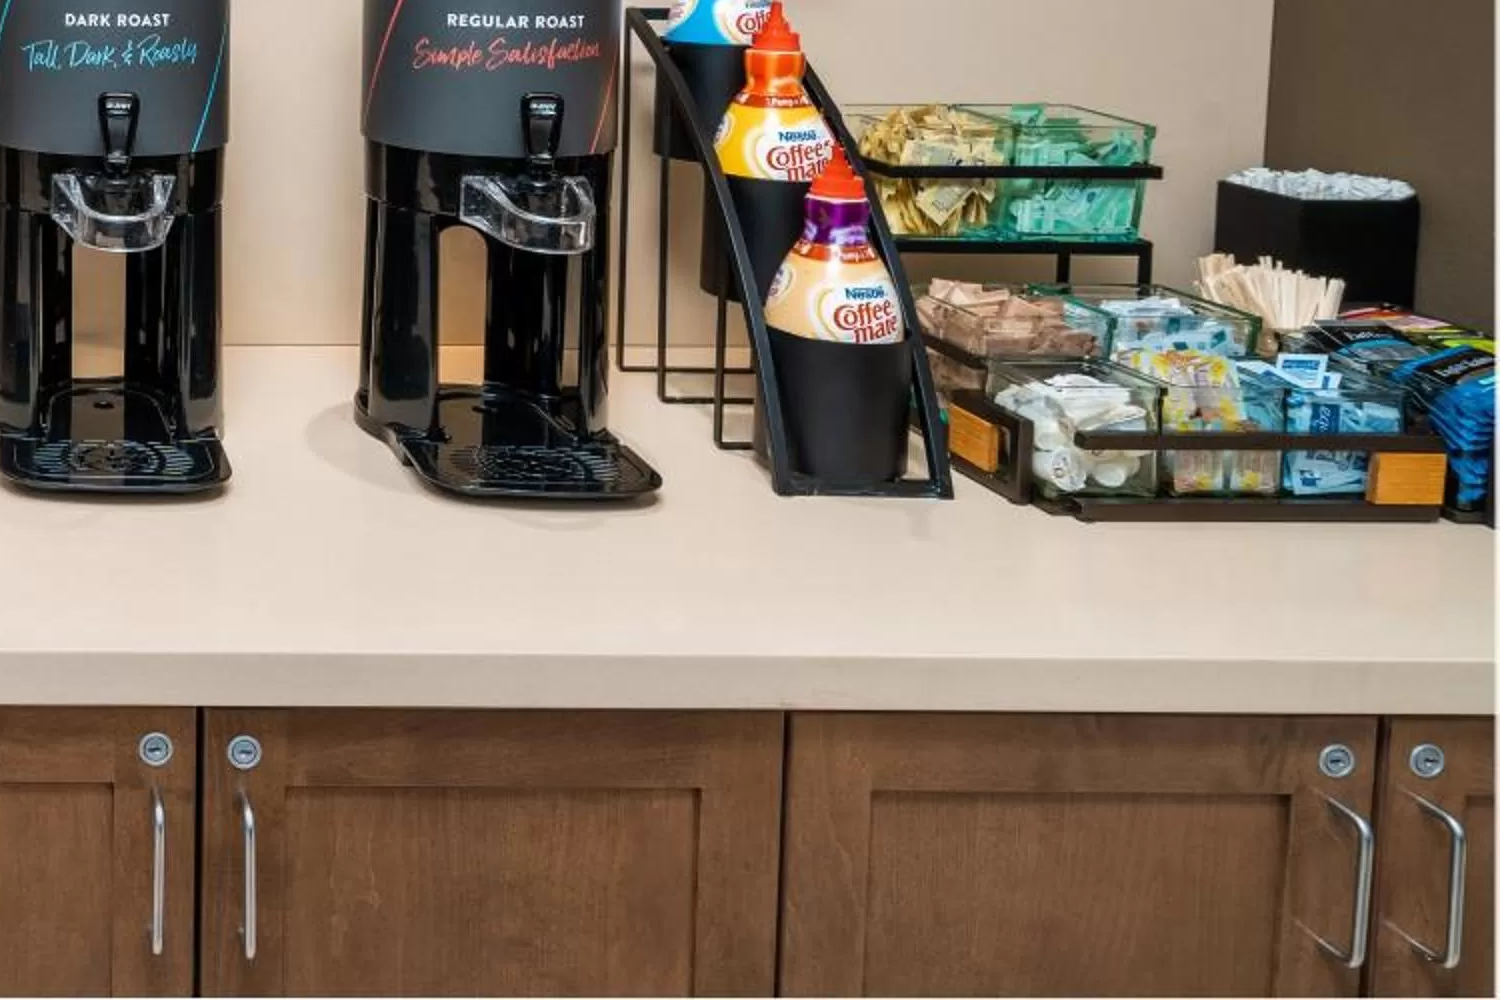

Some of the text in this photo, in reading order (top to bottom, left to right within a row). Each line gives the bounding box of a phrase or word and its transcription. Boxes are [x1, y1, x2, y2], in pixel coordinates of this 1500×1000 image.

[65, 13, 171, 27] DARK ROAST
[447, 13, 585, 28] REGULAR ROAST
[121, 40, 133, 66] &
[413, 36, 601, 71] Simple Satisfaction
[766, 142, 825, 170] Coffee
[834, 299, 892, 330] Coffee
